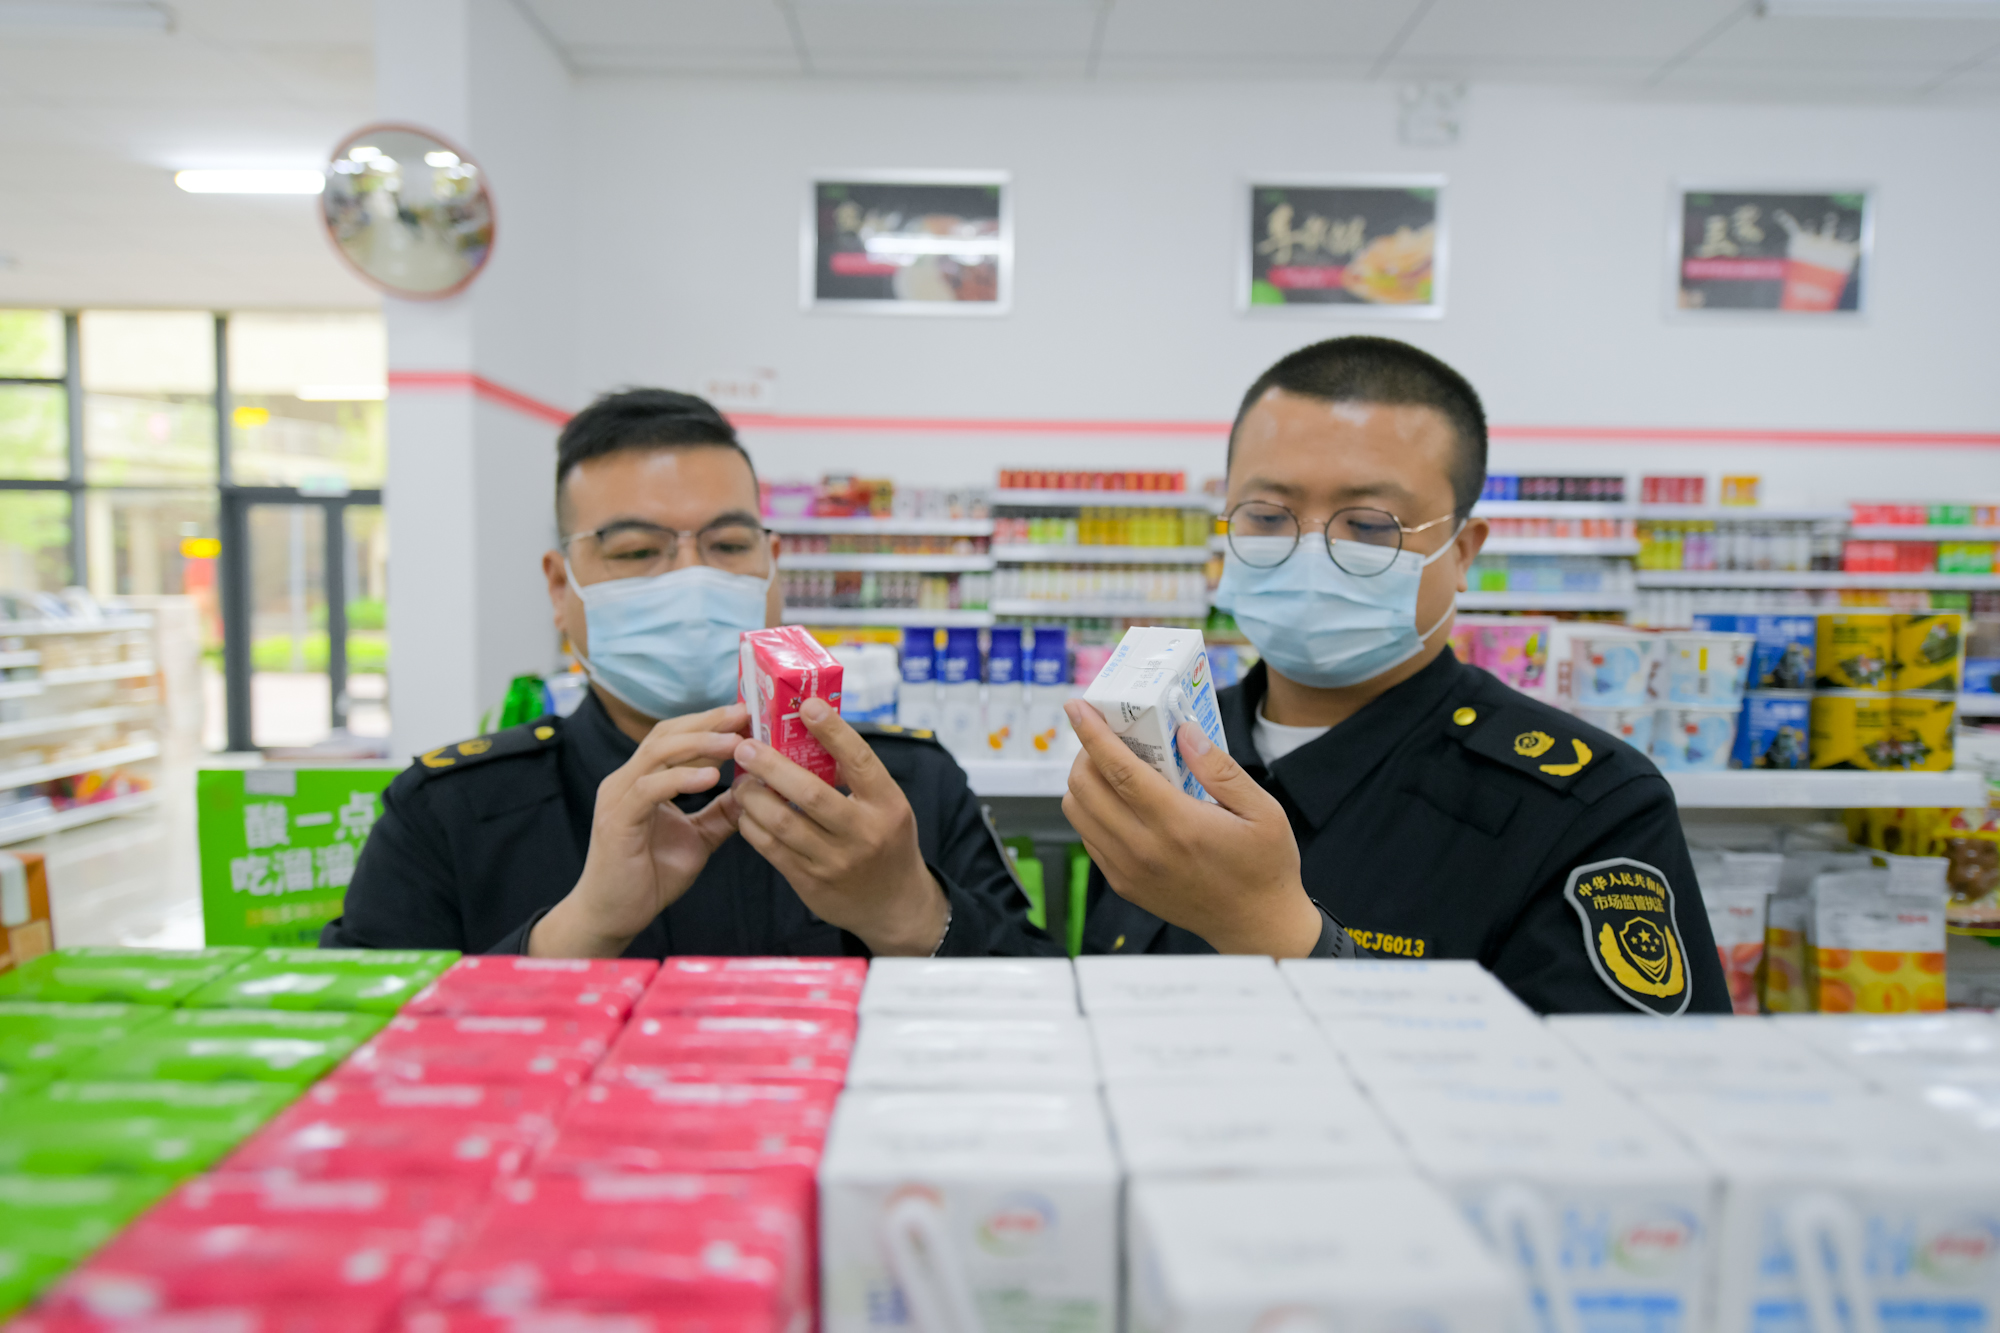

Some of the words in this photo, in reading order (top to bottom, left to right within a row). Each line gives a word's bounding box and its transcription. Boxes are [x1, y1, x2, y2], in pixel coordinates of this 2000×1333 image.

[243, 790, 376, 849] 酸一点
[230, 842, 364, 896] 吃溜溜
[1578, 872, 1665, 900] 中华人民共和国
[1592, 894, 1665, 913] 市场监管执法
